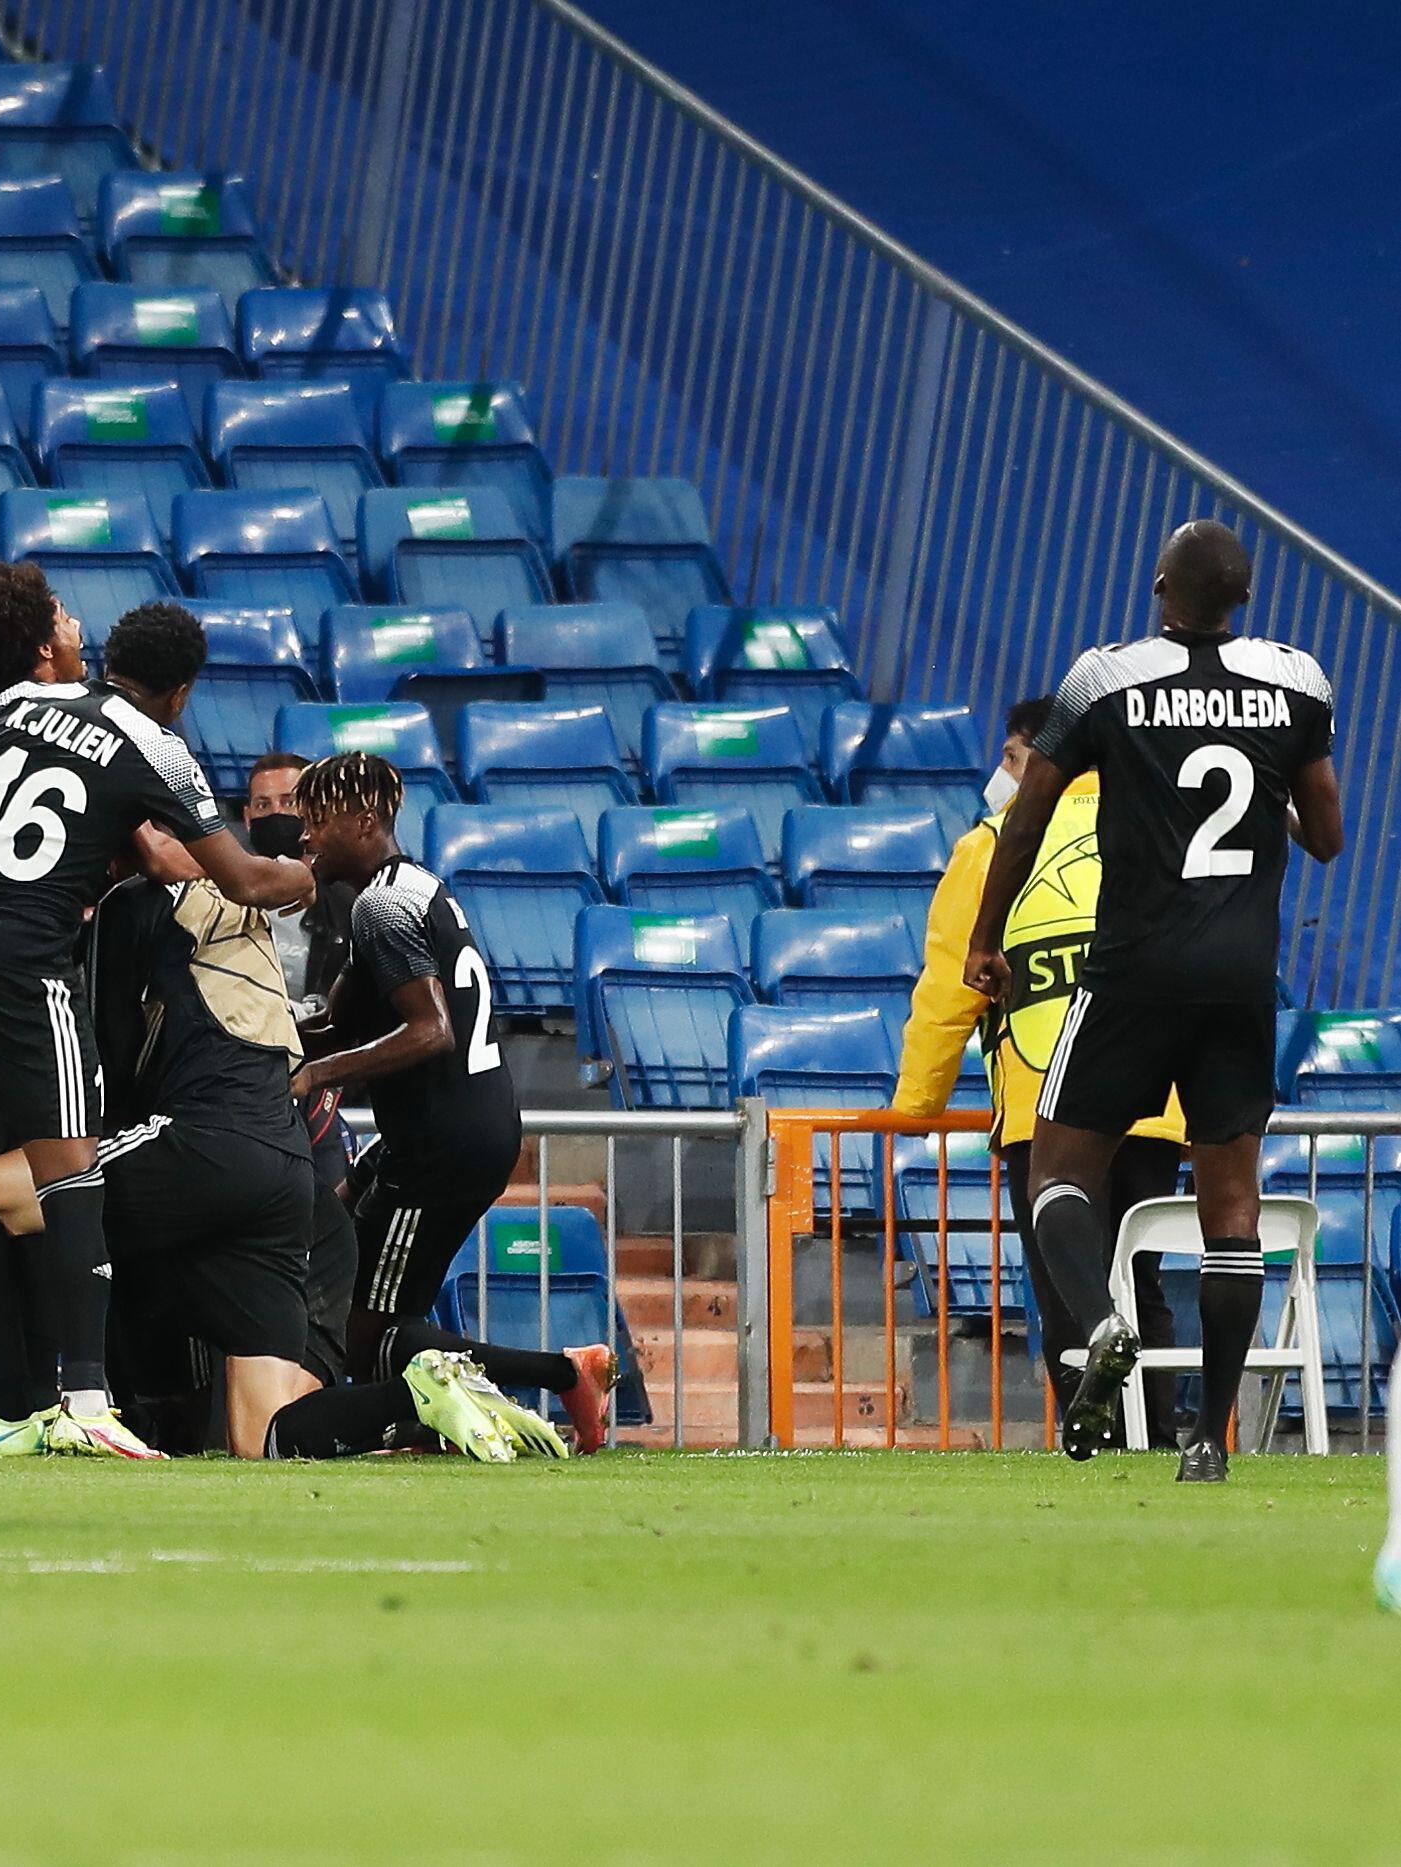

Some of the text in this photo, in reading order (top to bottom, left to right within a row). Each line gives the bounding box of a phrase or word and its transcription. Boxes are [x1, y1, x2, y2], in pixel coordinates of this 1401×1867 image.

[5, 700, 124, 768] K.JULIEN
[1126, 688, 1292, 728] D.ARBOLEDA
[1177, 744, 1255, 880] 2
[1028, 942, 1092, 992] ST
